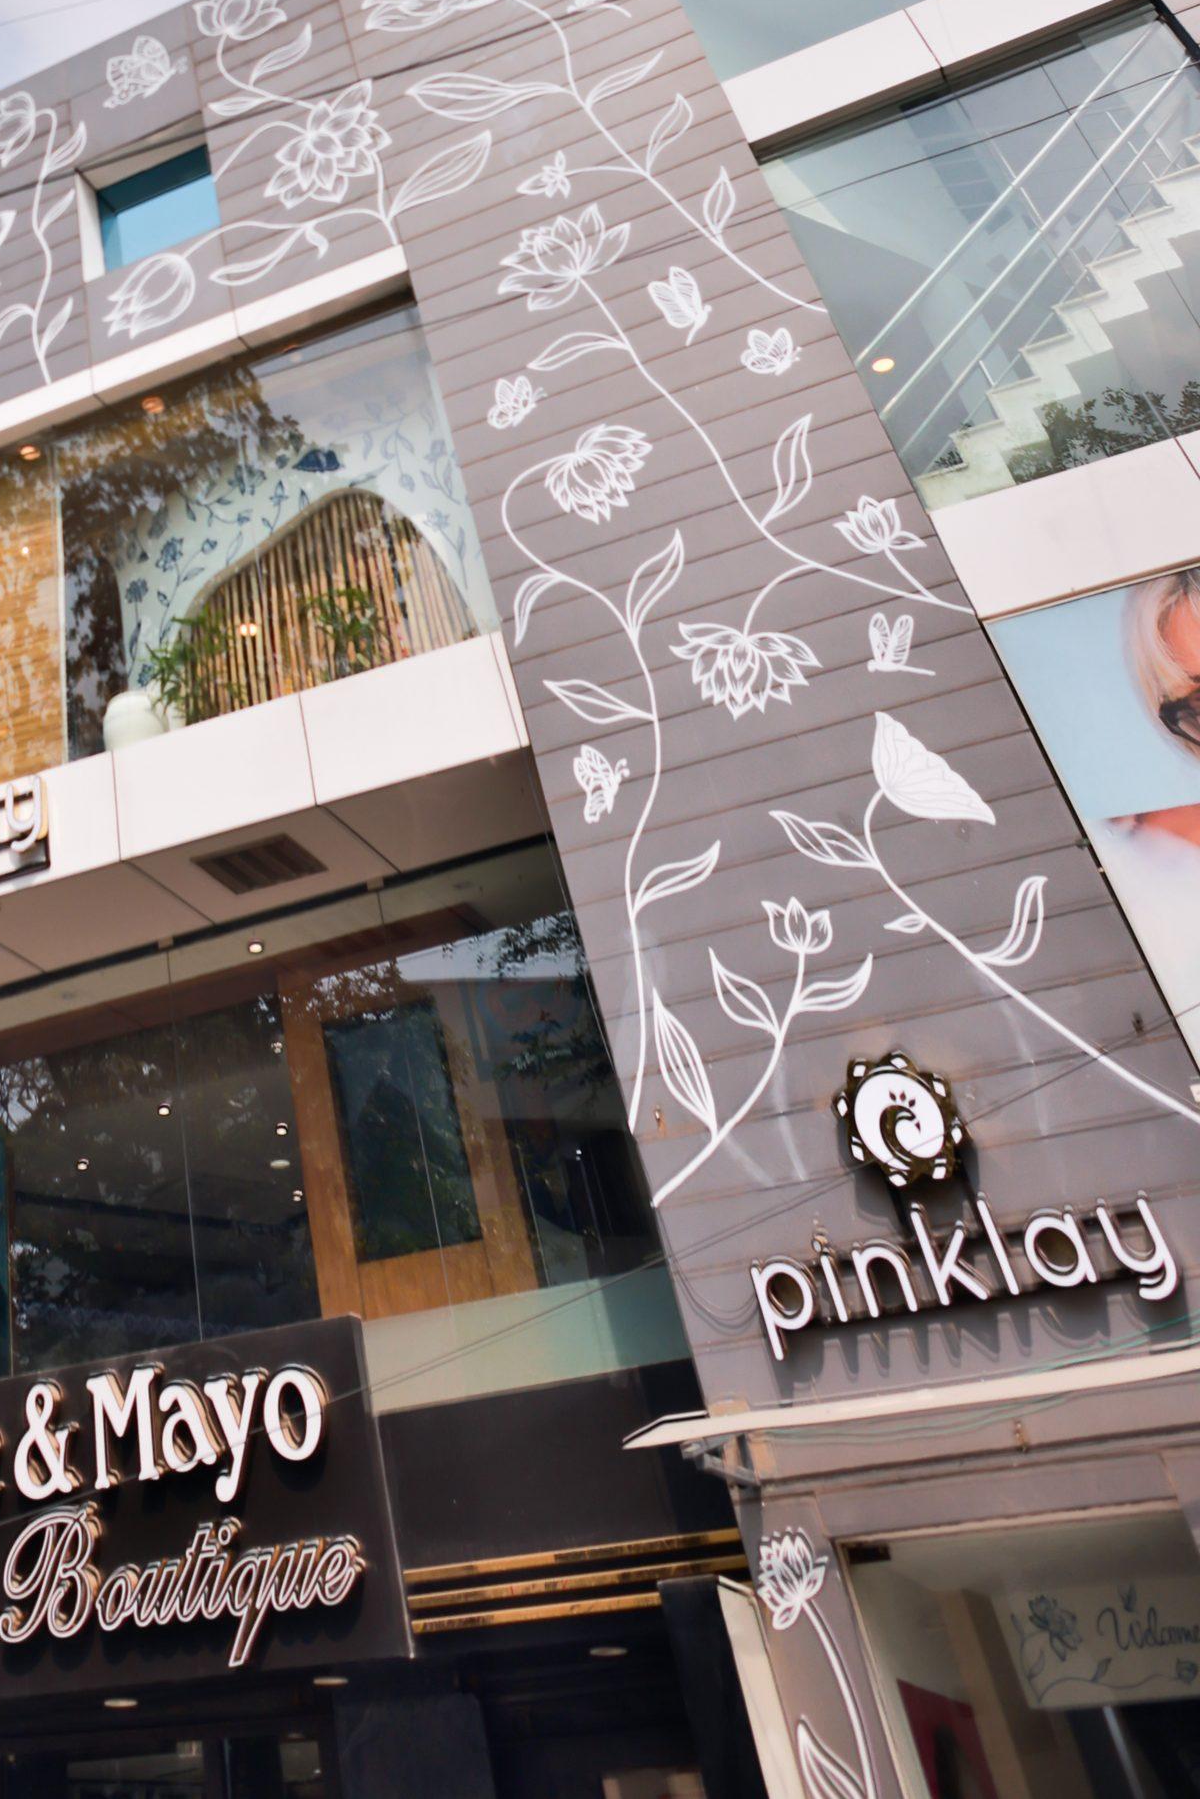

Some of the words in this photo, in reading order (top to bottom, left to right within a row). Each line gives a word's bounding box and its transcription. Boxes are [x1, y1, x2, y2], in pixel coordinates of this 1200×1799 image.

[750, 1190, 1178, 1361] pinklay
[13, 1378, 78, 1501] &
[86, 1360, 328, 1502] Mayo
